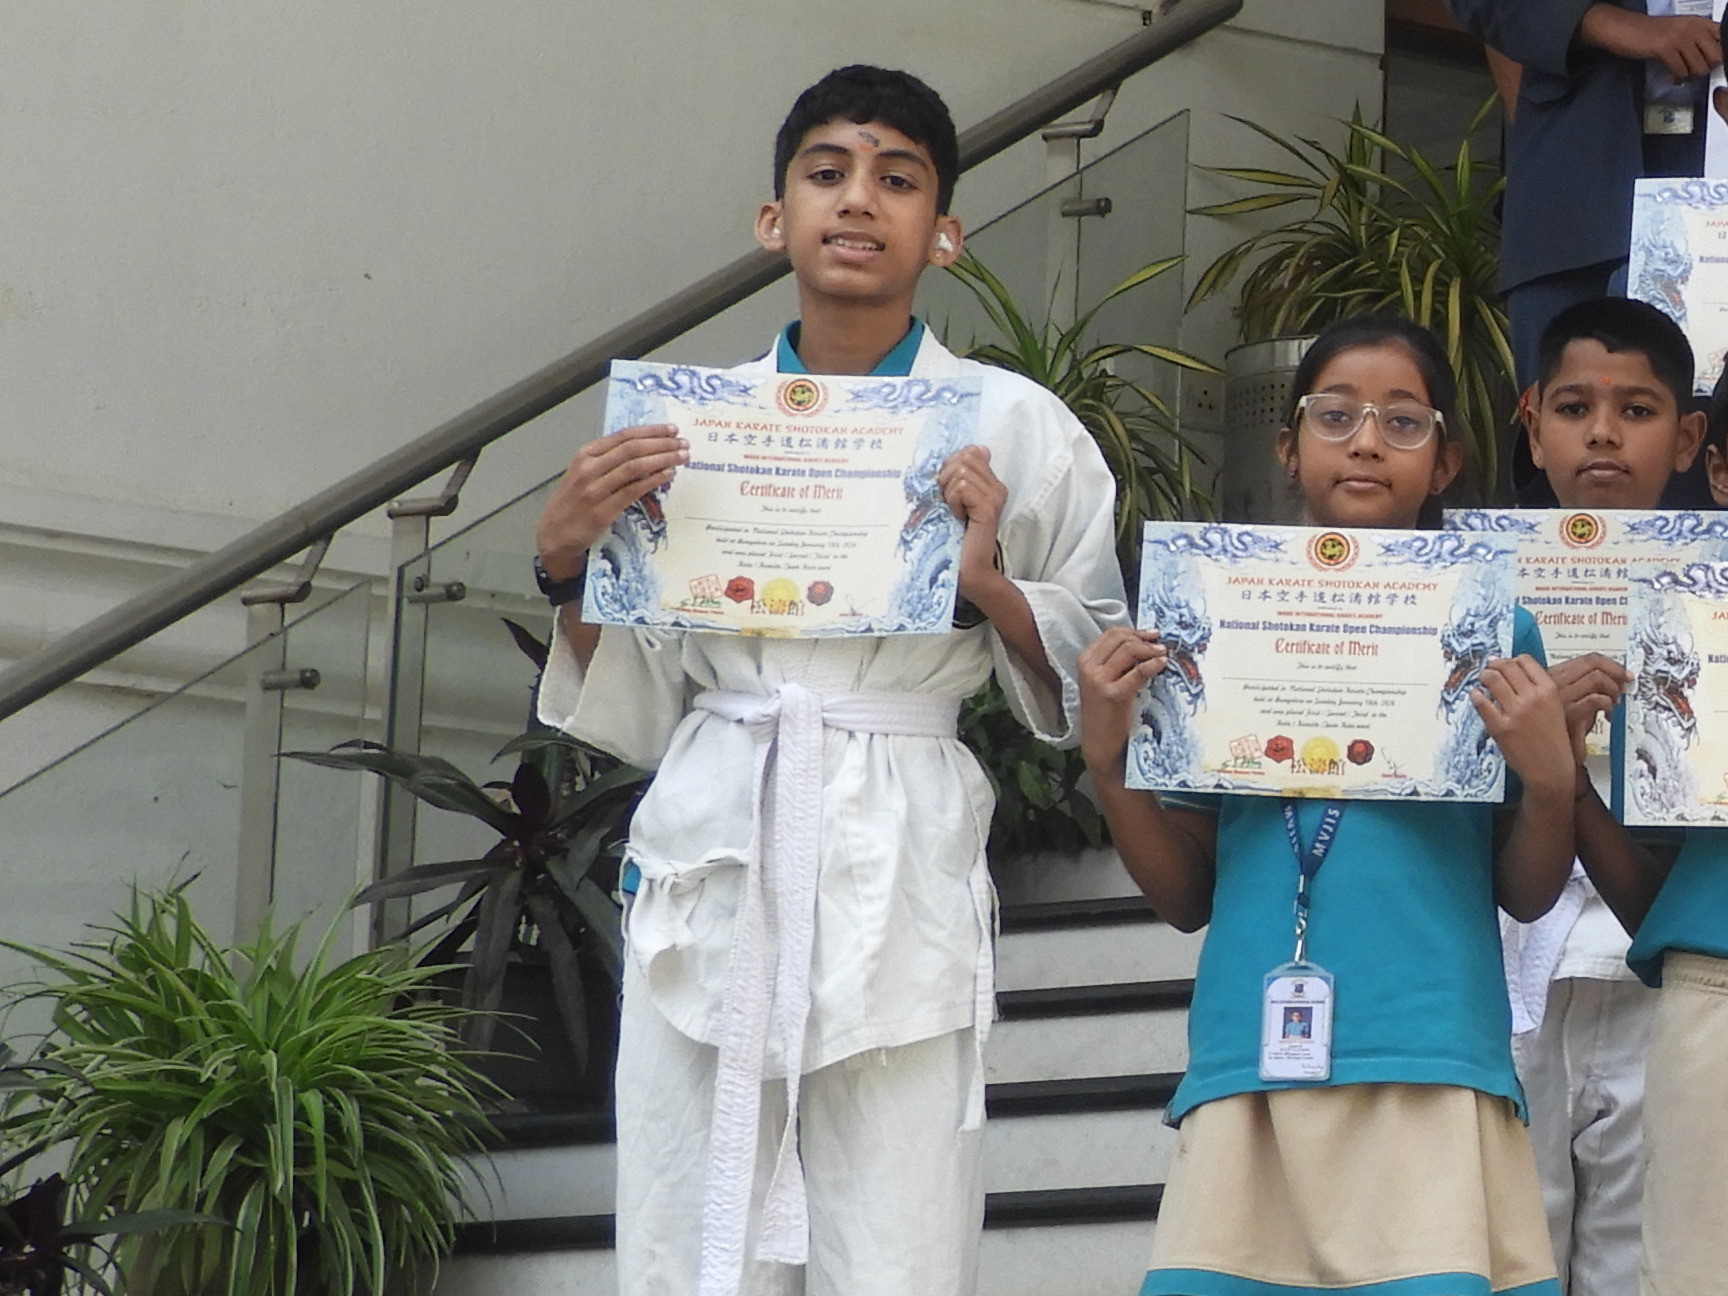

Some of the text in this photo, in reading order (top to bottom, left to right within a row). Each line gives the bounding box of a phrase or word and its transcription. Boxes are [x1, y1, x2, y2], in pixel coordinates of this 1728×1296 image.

[692, 419, 903, 438] JAPAN KARATE SHOTOKAN ACADEMY
[726, 464, 773, 475] Shotokan
[774, 466, 806, 477] Karate
[808, 468, 832, 479] Open
[834, 469, 901, 482] Championship
[738, 480, 843, 500] Certificate of Merit
[1226, 577, 1437, 591] JAPAN KARATE SHOTOKAN ACADEMY
[1219, 620, 1437, 637] National Shotokan Karate Open Championship
[1274, 637, 1378, 657] Certificate of Merit
[1312, 807, 1340, 857] MVJIS
